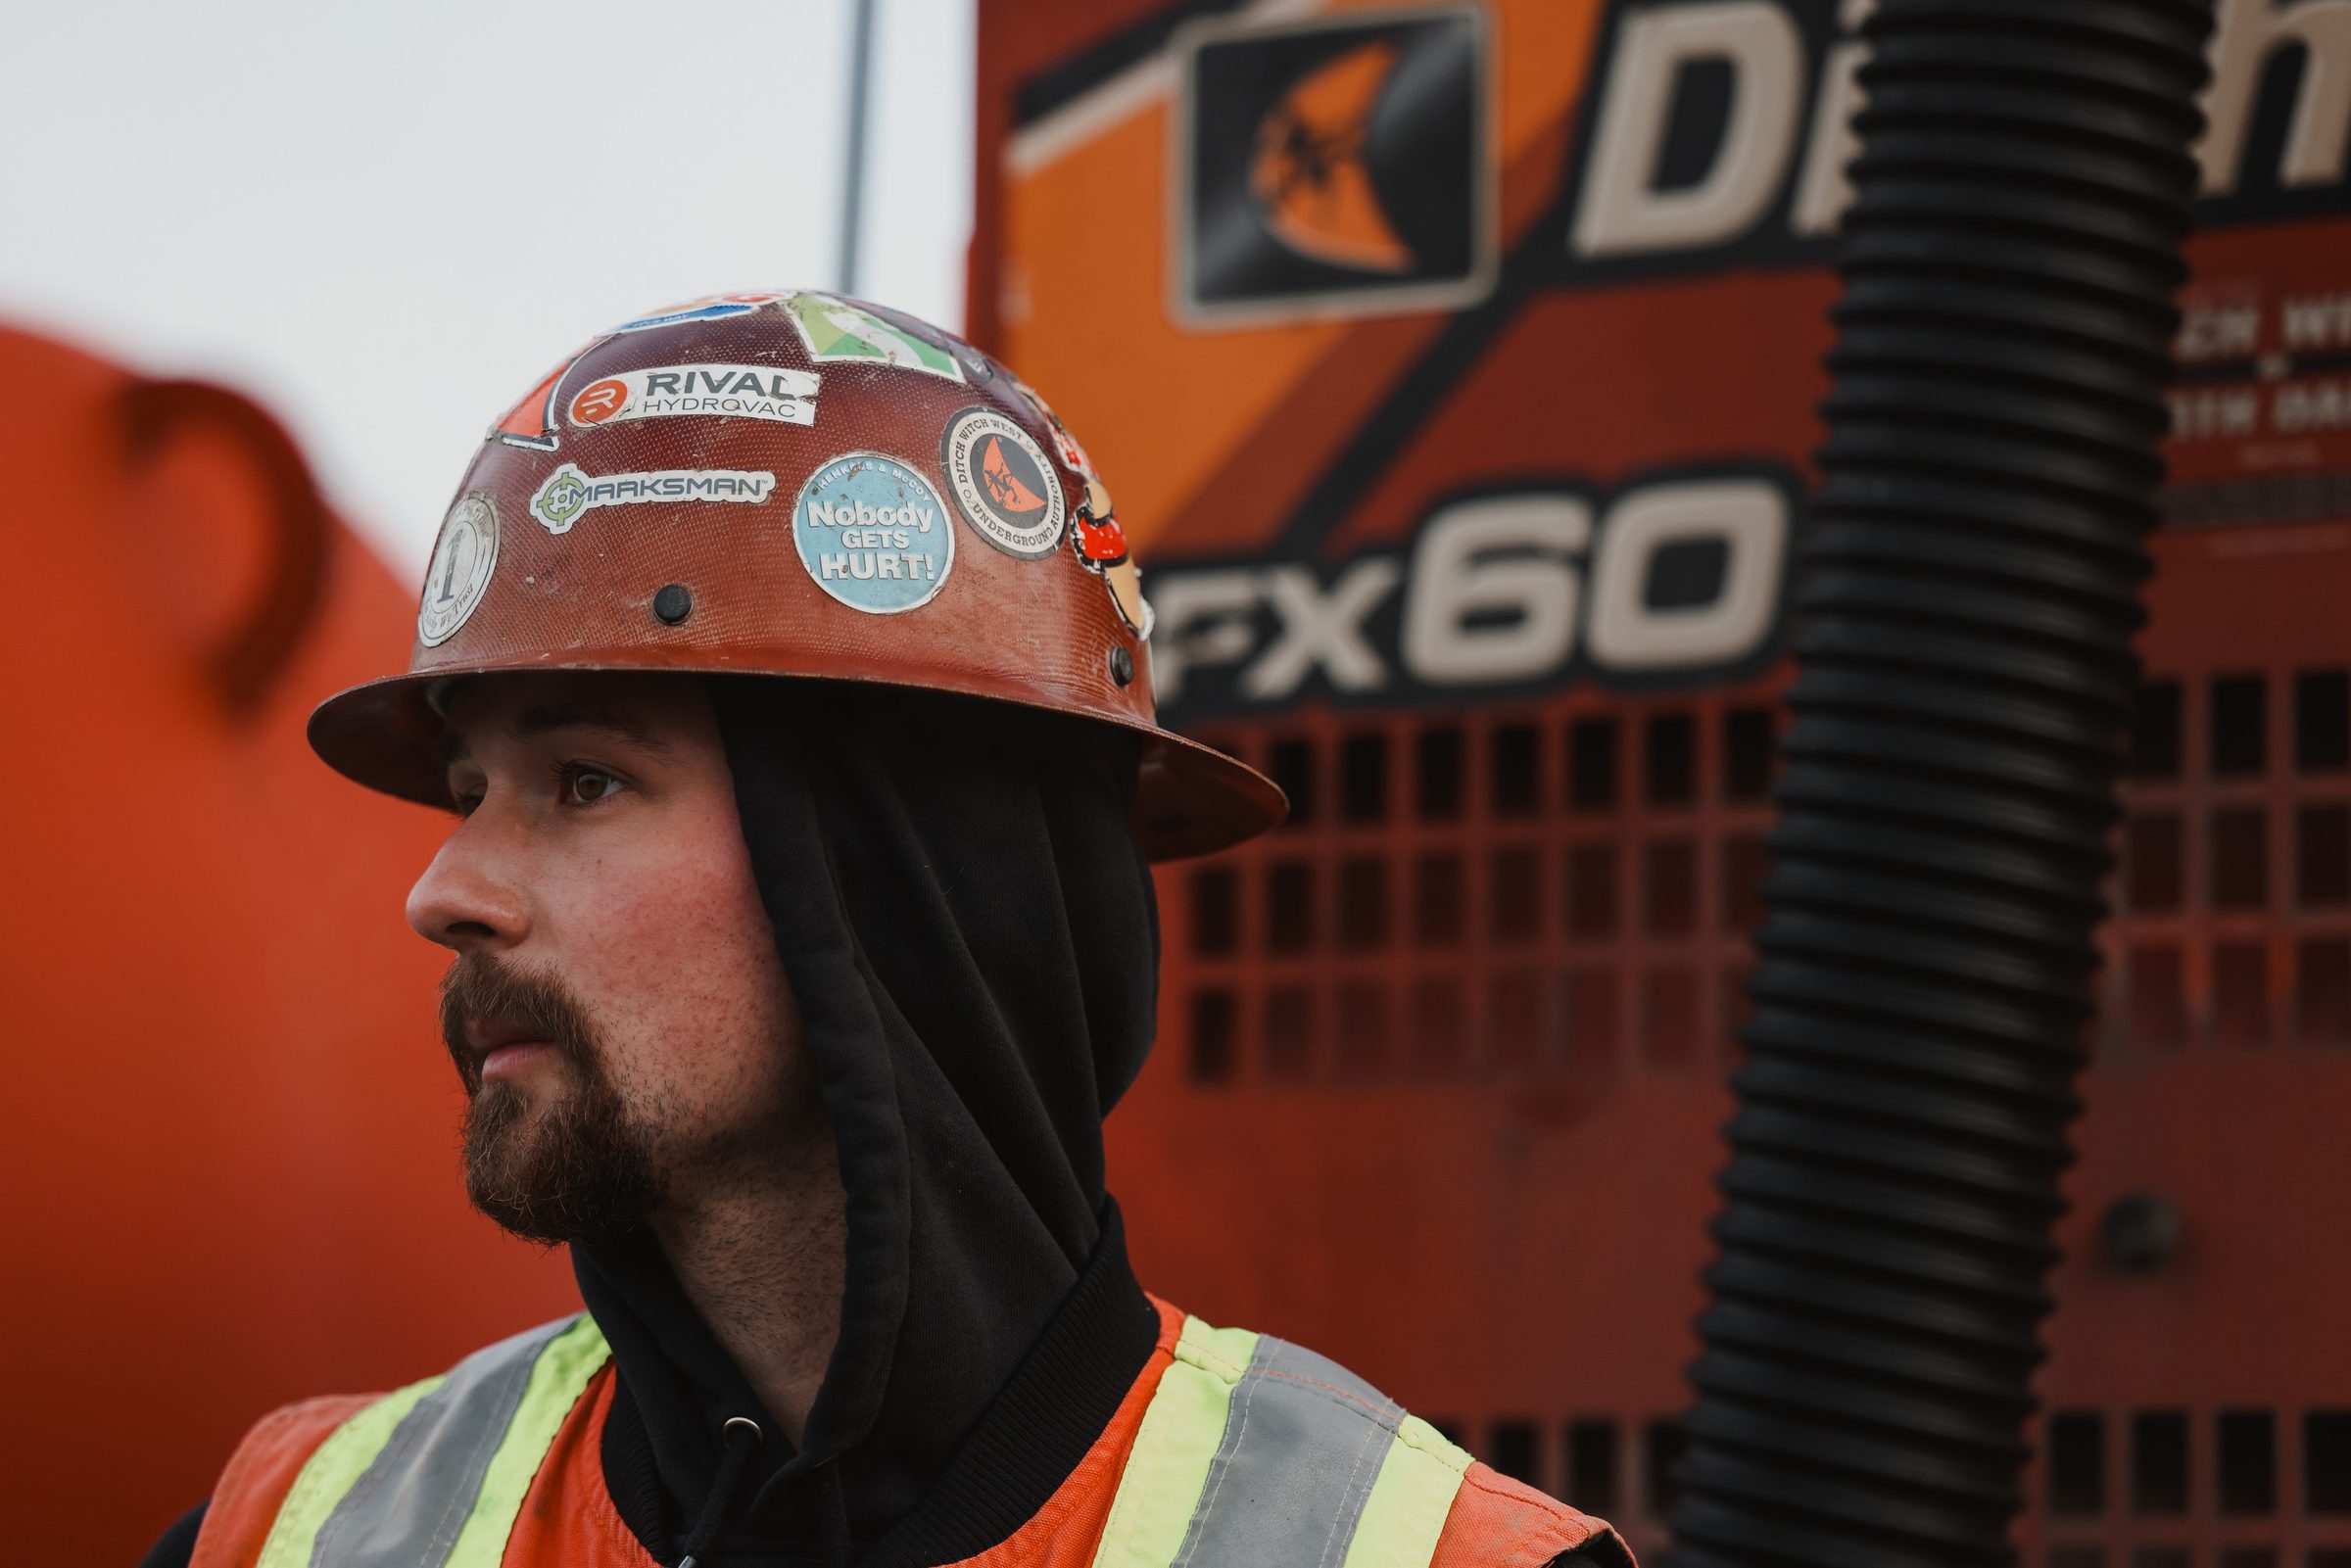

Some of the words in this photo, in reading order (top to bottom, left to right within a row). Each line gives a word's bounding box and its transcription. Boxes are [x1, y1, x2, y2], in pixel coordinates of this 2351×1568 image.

[647, 370, 796, 402] RIVAL
[644, 398, 796, 418] HYDROVAC
[959, 418, 989, 442] WITCH
[989, 418, 1025, 441] WEST
[878, 462, 887, 473] &
[955, 442, 968, 484] DITCH
[568, 476, 762, 505] MARKSMAN
[973, 502, 1054, 546] UNDERGROUND
[1034, 453, 1061, 530] AUTHORITY
[806, 499, 934, 533] Nobody
[840, 530, 910, 549] GETS
[819, 551, 936, 581] HURT!
